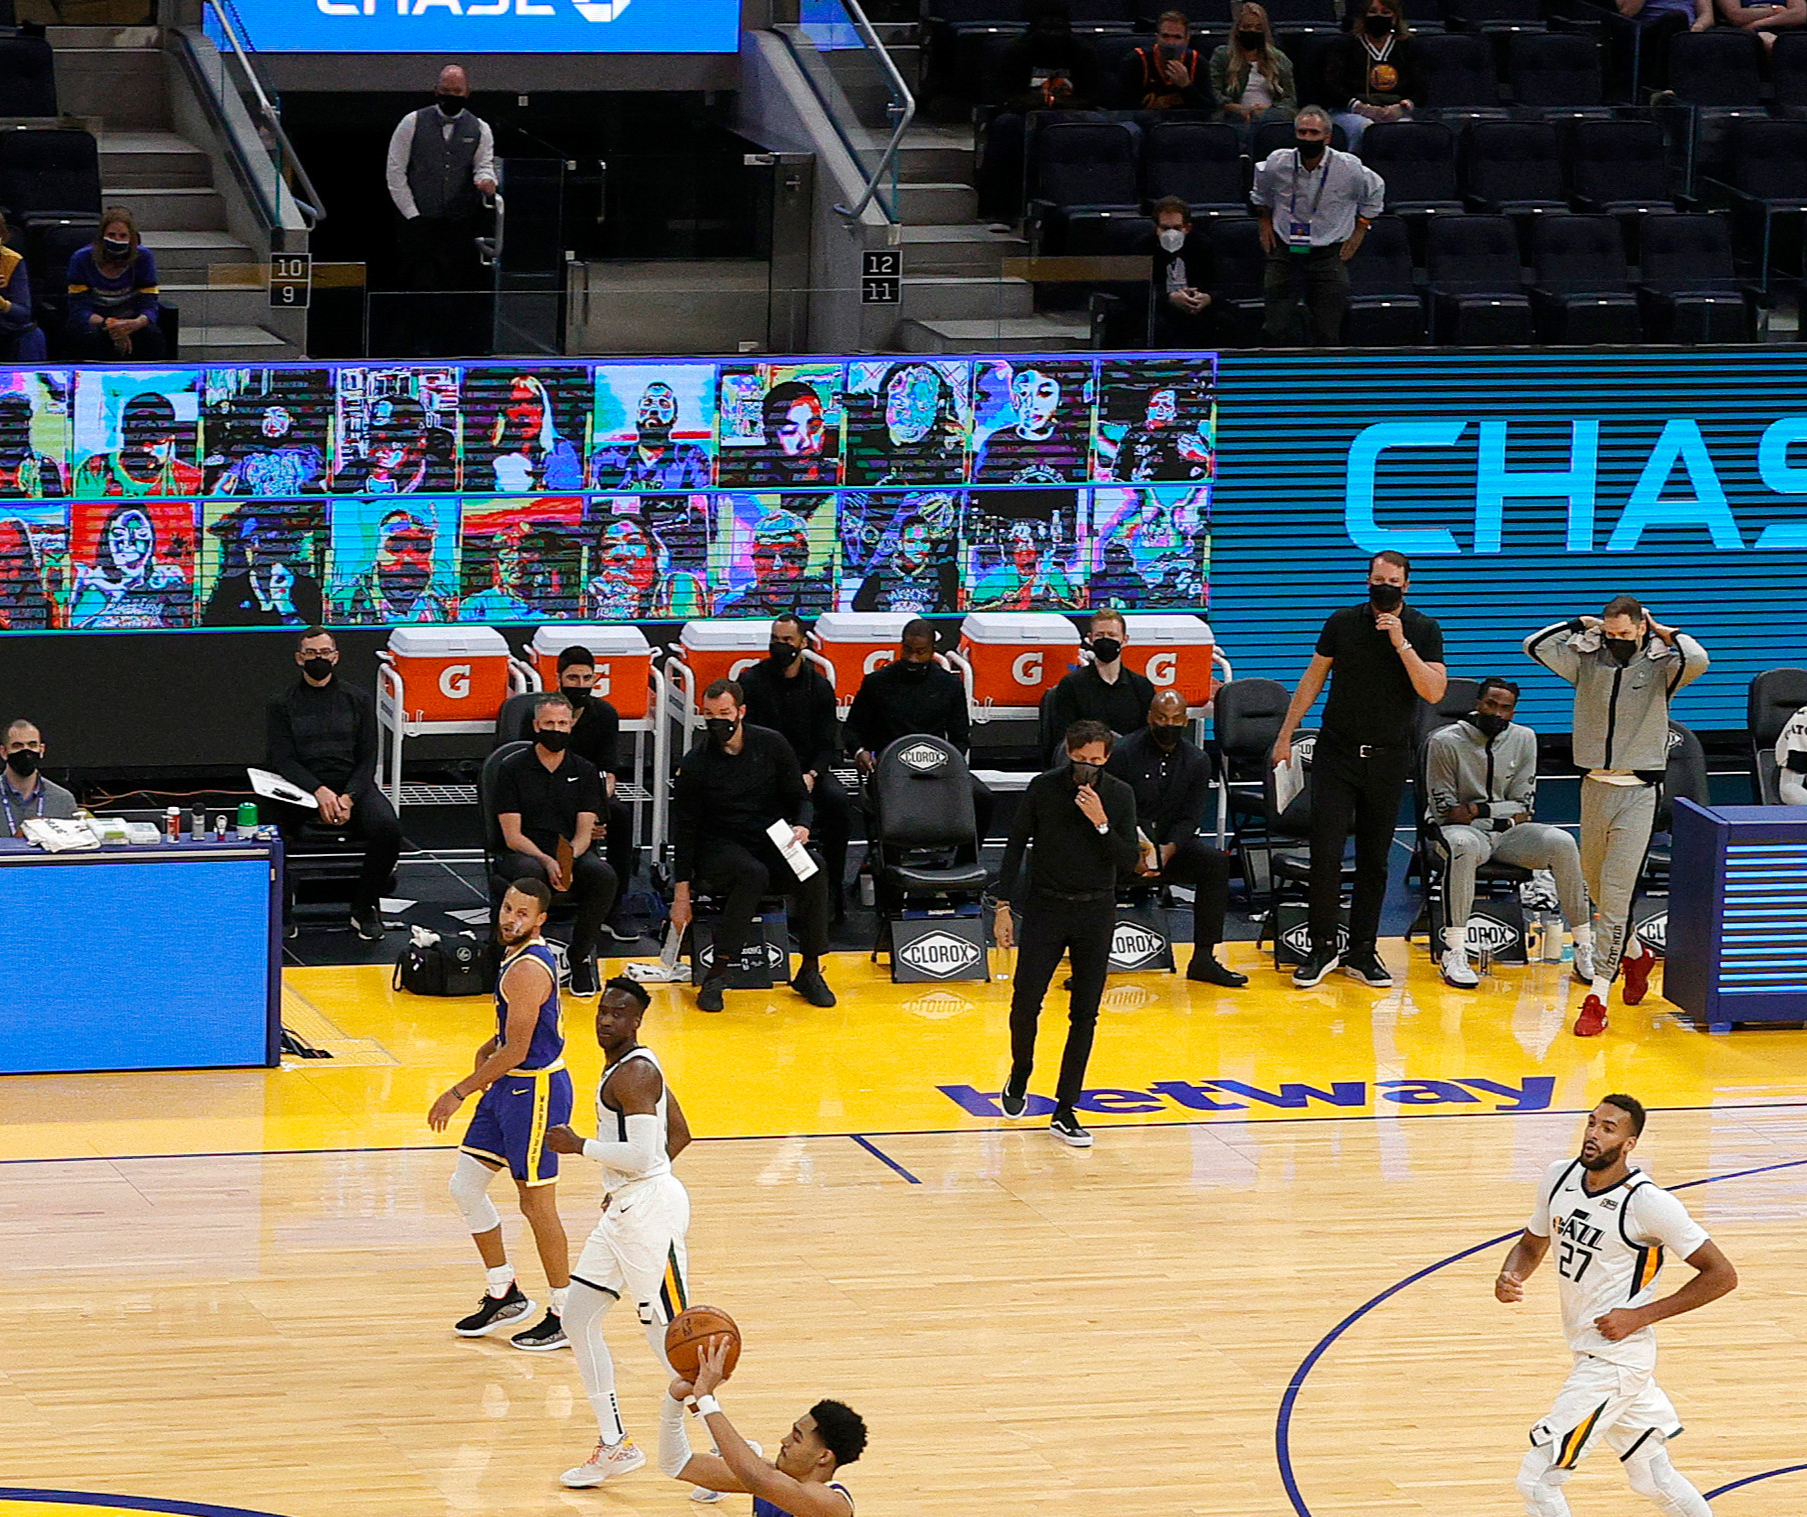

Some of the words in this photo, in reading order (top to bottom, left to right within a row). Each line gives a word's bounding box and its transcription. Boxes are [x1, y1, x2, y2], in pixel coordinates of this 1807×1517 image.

[278, 258, 302, 277] 10
[869, 256, 892, 273] 12
[283, 286, 294, 303] 9
[869, 283, 892, 300] 11
[1012, 651, 1044, 686] G
[1145, 652, 1178, 687] G
[438, 663, 472, 699] G
[903, 749, 943, 765] CLOROX
[909, 945, 972, 965] CLOROX
[1110, 936, 1157, 957] LOROX
[936, 1076, 1556, 1119] betway
[1553, 1208, 1605, 1251] JAZZ
[1558, 1241, 1594, 1284] 27
